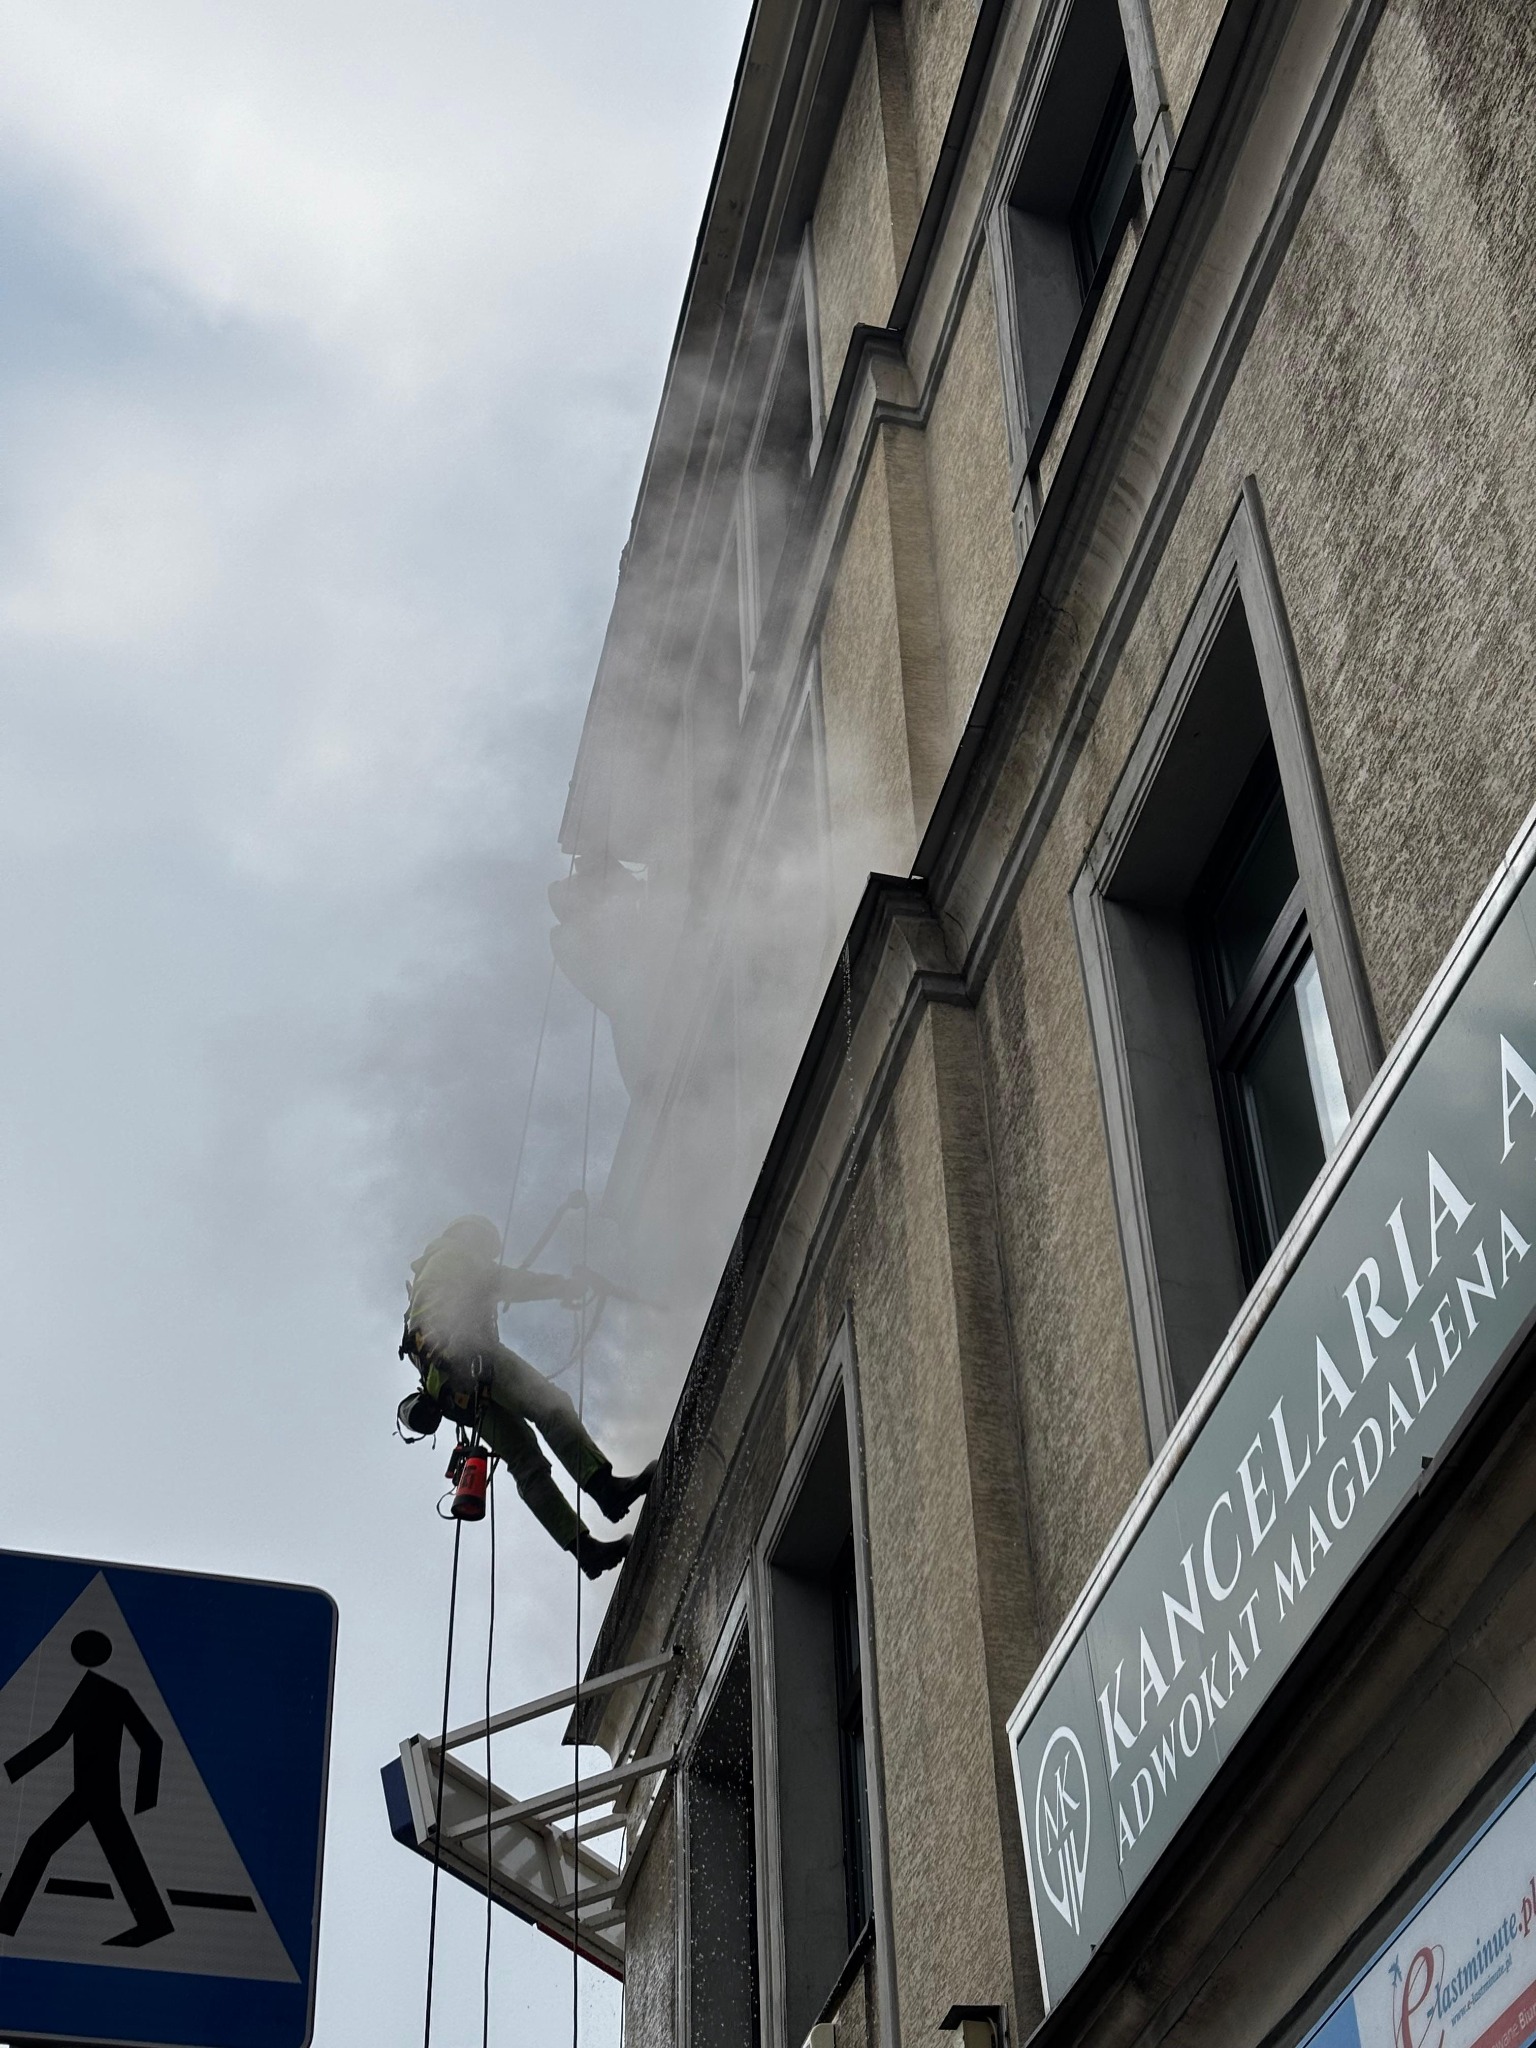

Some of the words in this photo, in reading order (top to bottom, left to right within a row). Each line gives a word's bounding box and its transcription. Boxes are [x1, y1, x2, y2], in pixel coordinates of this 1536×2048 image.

[1098, 1150, 1477, 1782] KANCELARIA
[1118, 1589, 1264, 1866] ADWOKAT
[1273, 1208, 1532, 1623] MAGDALENA
